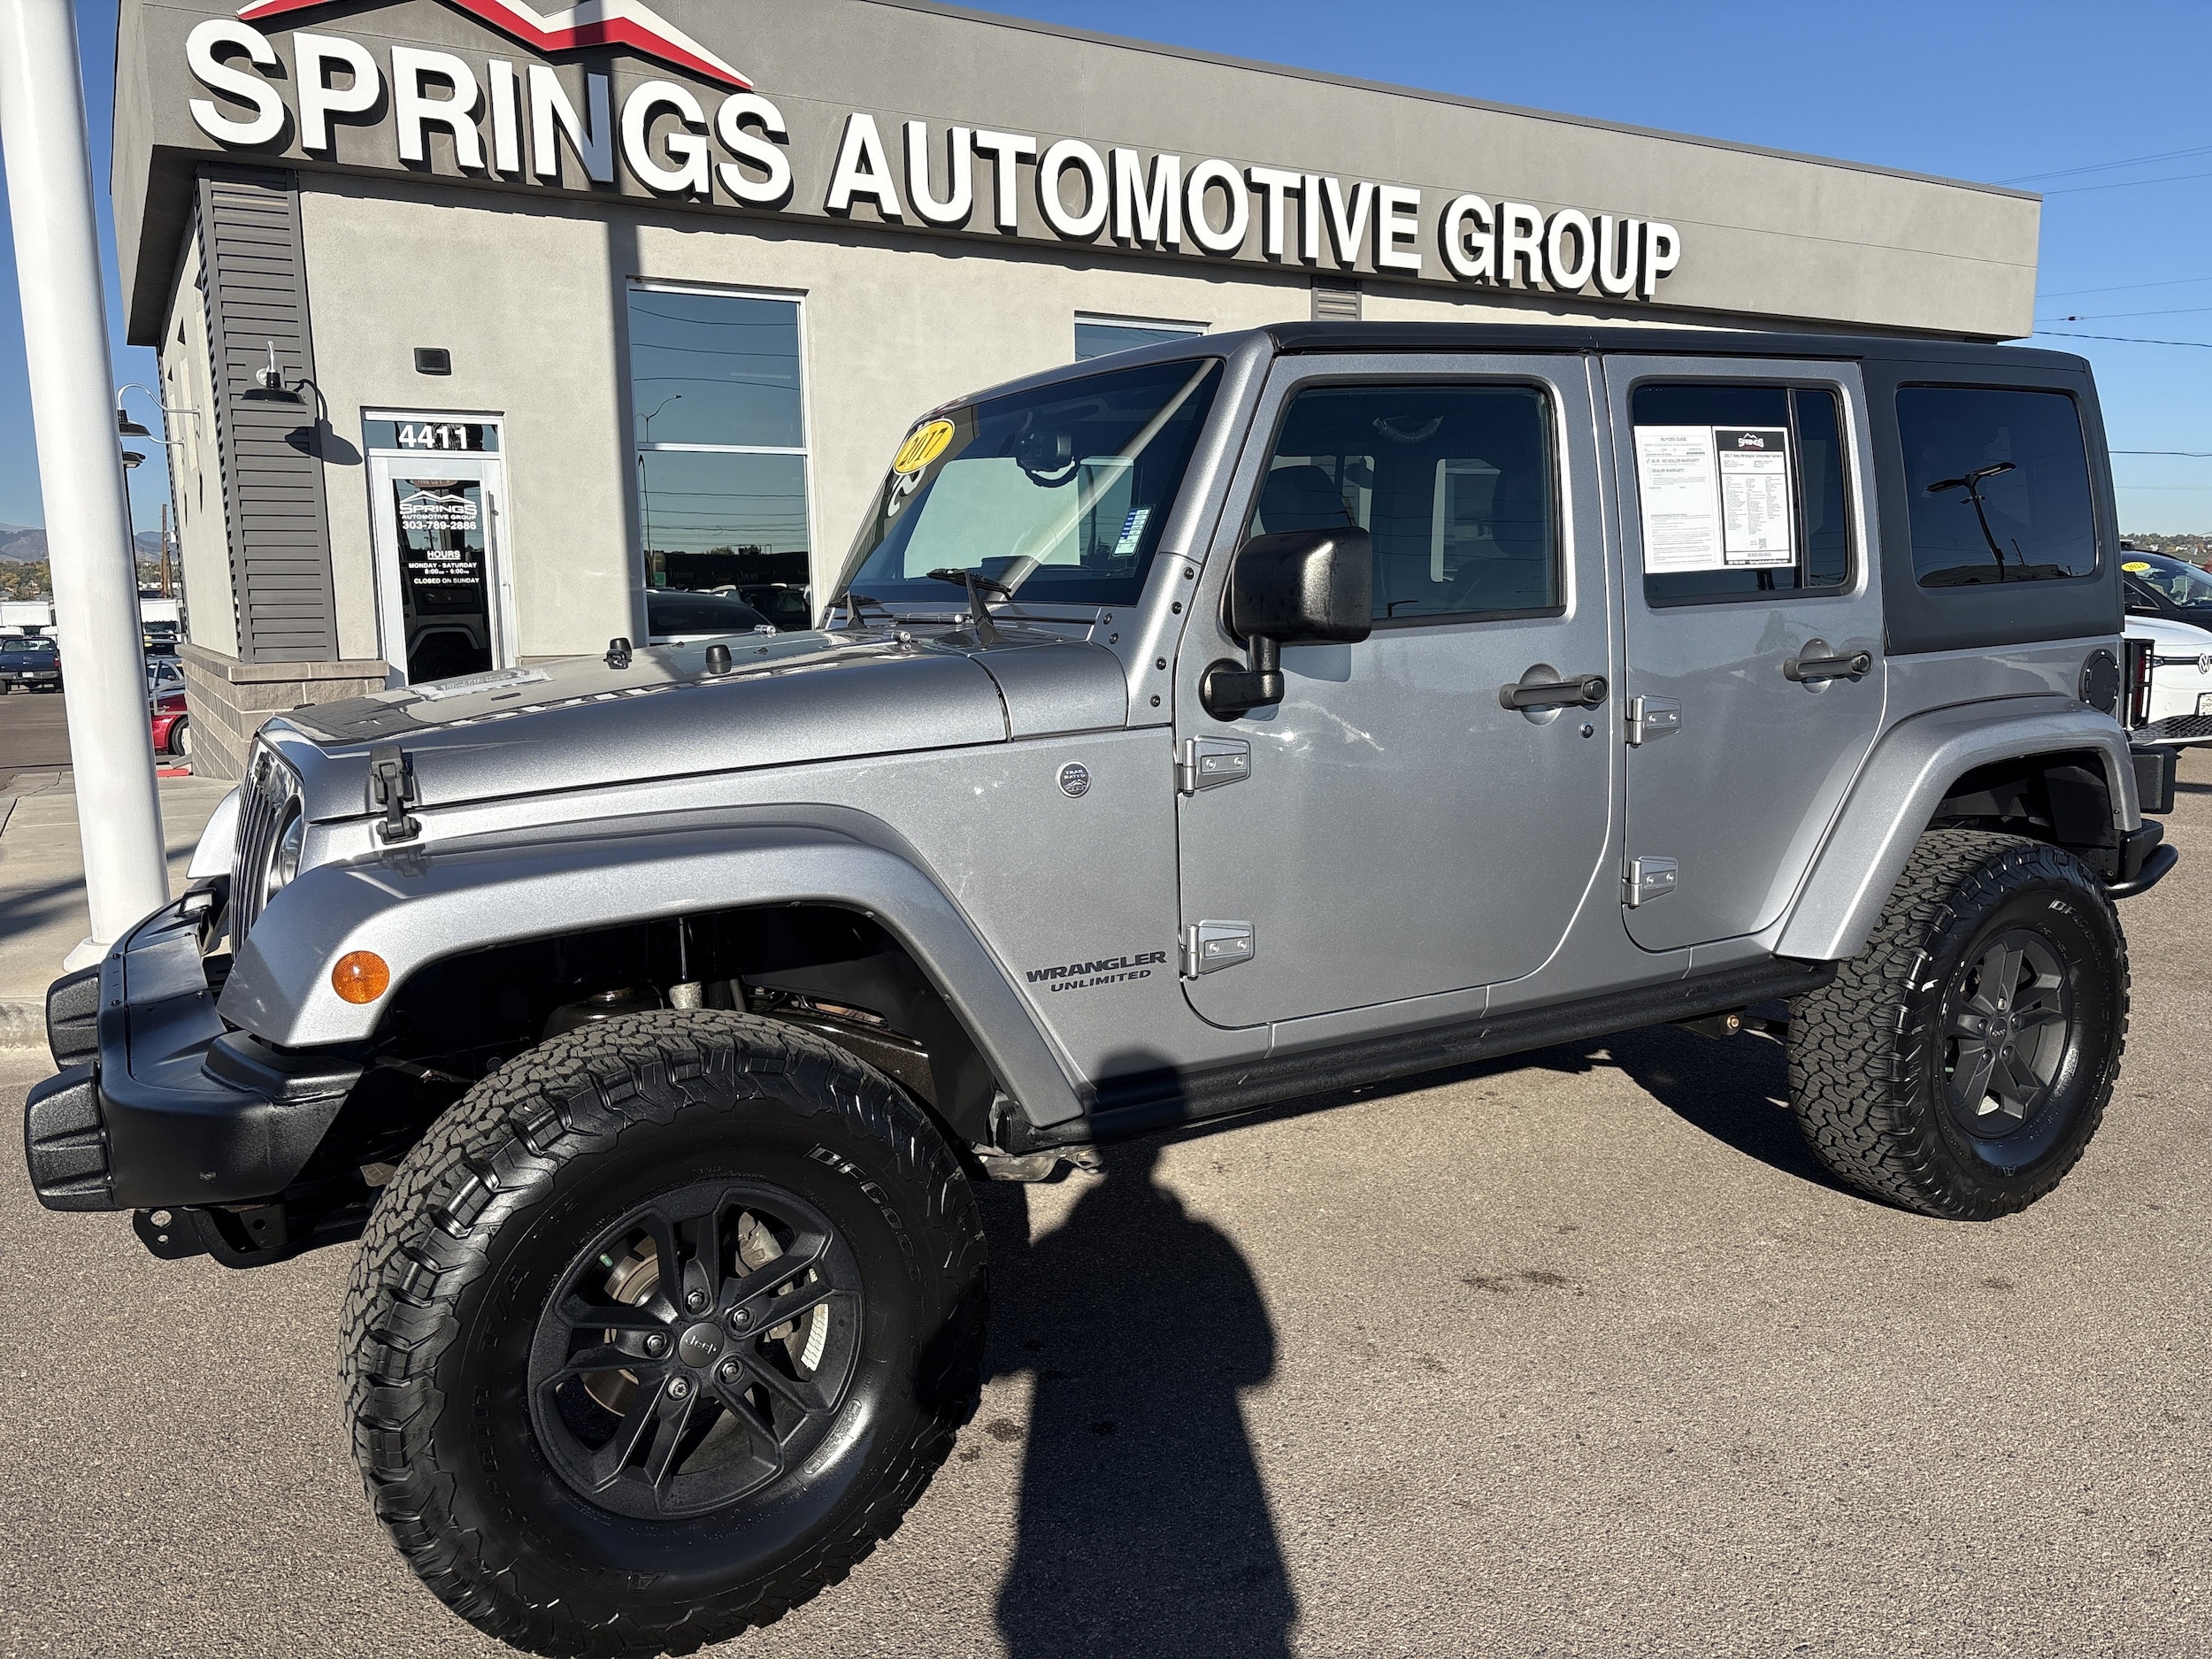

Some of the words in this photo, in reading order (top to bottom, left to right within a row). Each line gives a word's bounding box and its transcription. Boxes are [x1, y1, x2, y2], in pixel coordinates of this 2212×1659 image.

[186, 18, 794, 204] SPRINGS
[824, 111, 1423, 270] AUTOMOTIVE
[1442, 193, 1682, 297] GROUP
[398, 424, 468, 449] 4411
[897, 426, 949, 468] 2017
[399, 503, 478, 515] SPRINGS
[402, 520, 477, 530] 303-789-2886
[427, 550, 461, 559] HOURS
[1025, 950, 1168, 983] WRANGLER
[1050, 969, 1153, 992] UNLIMITED
[685, 1334, 717, 1355] Jeep
